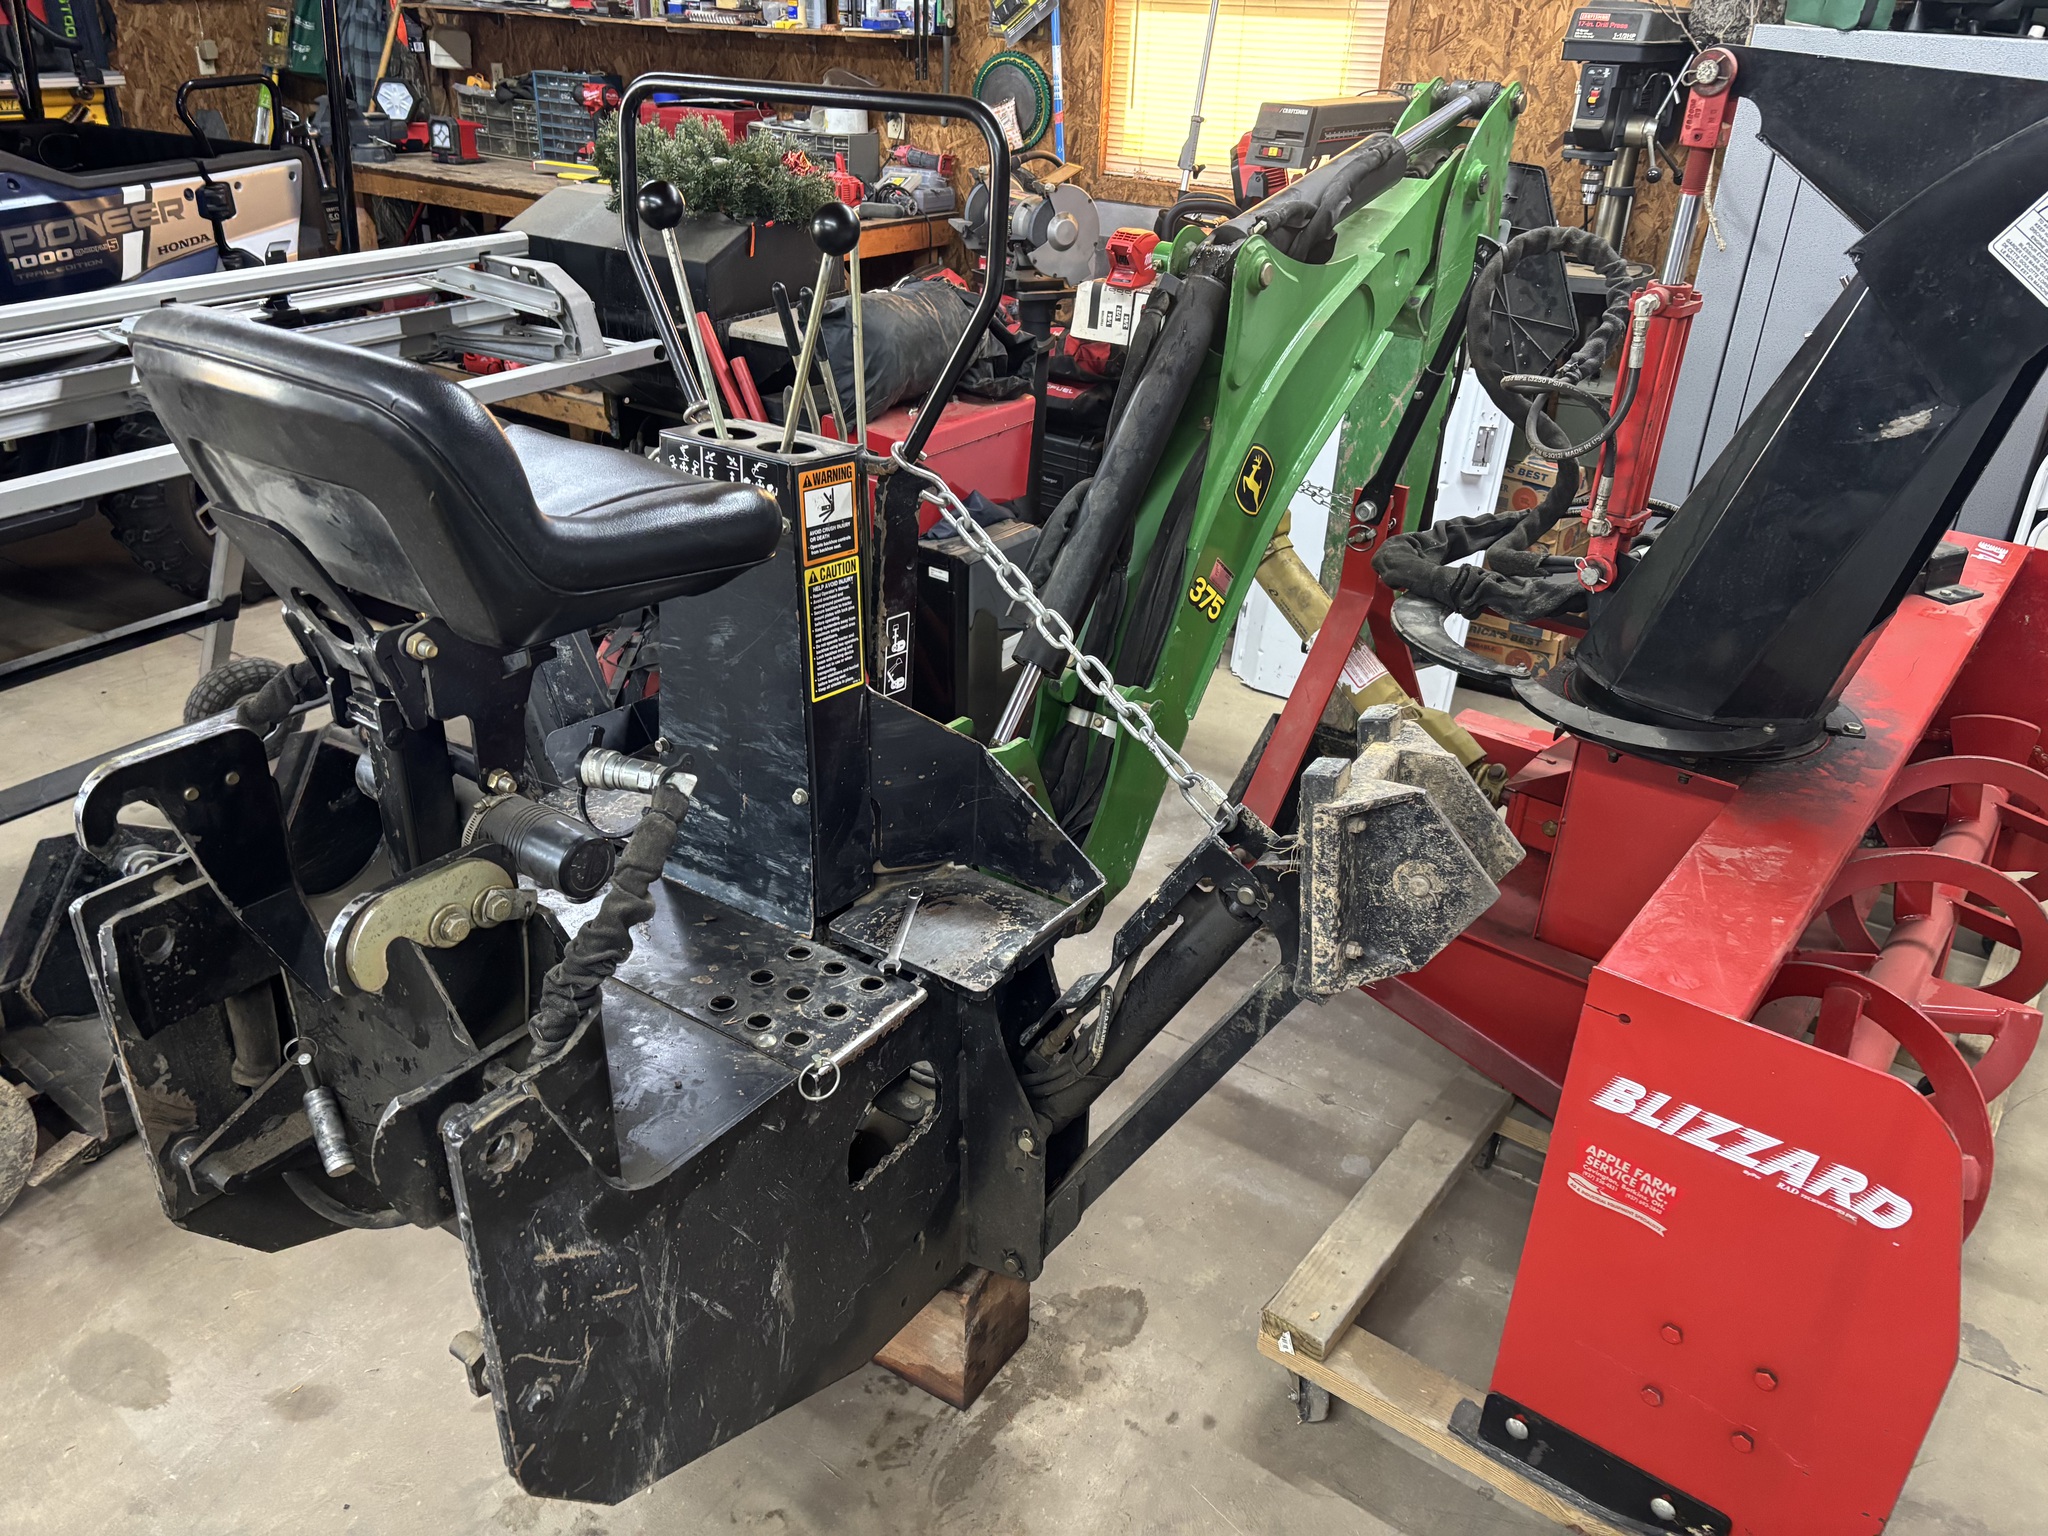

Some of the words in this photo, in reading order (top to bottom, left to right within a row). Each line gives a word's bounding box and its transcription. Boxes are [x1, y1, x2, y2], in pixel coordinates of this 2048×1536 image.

[1, 198, 185, 254] PIONEER
[158, 234, 211, 255] HONDA
[9, 248, 75, 270] 1000
[17, 268, 55, 281] TRAIL
[56, 258, 103, 273] EDITION
[1565, 448, 1583, 458] MADE
[1584, 442, 1591, 450] IN
[812, 465, 852, 486] WARNING
[1518, 468, 1548, 482] BEST
[817, 533, 830, 541] DEATH
[822, 525, 836, 533] CRUSH
[820, 559, 856, 581] CAUTION
[813, 584, 824, 593] HELP
[825, 580, 838, 589] AVOID
[839, 576, 853, 585] INJURY
[1190, 577, 1225, 619] 375
[1510, 634, 1544, 647] BEST
[1589, 1076, 1912, 1229] BLIZZARD
[1585, 1145, 1631, 1173] APPLE
[1634, 1168, 1677, 1197] FARM
[1585, 1156, 1637, 1187] SERVICE
[1640, 1183, 1668, 1205] INC.
[1583, 1164, 1619, 1186] Covington,
[1621, 1184, 1649, 1202] Botkins,
[1651, 1200, 1665, 1210] OH.
[1776, 1182, 1800, 1195] RAD
[1581, 1190, 1607, 1205] INDUSTRIAL
[1607, 1202, 1634, 1216] EQUIPMENT
[1635, 1214, 1661, 1232] SPECIALISTS
